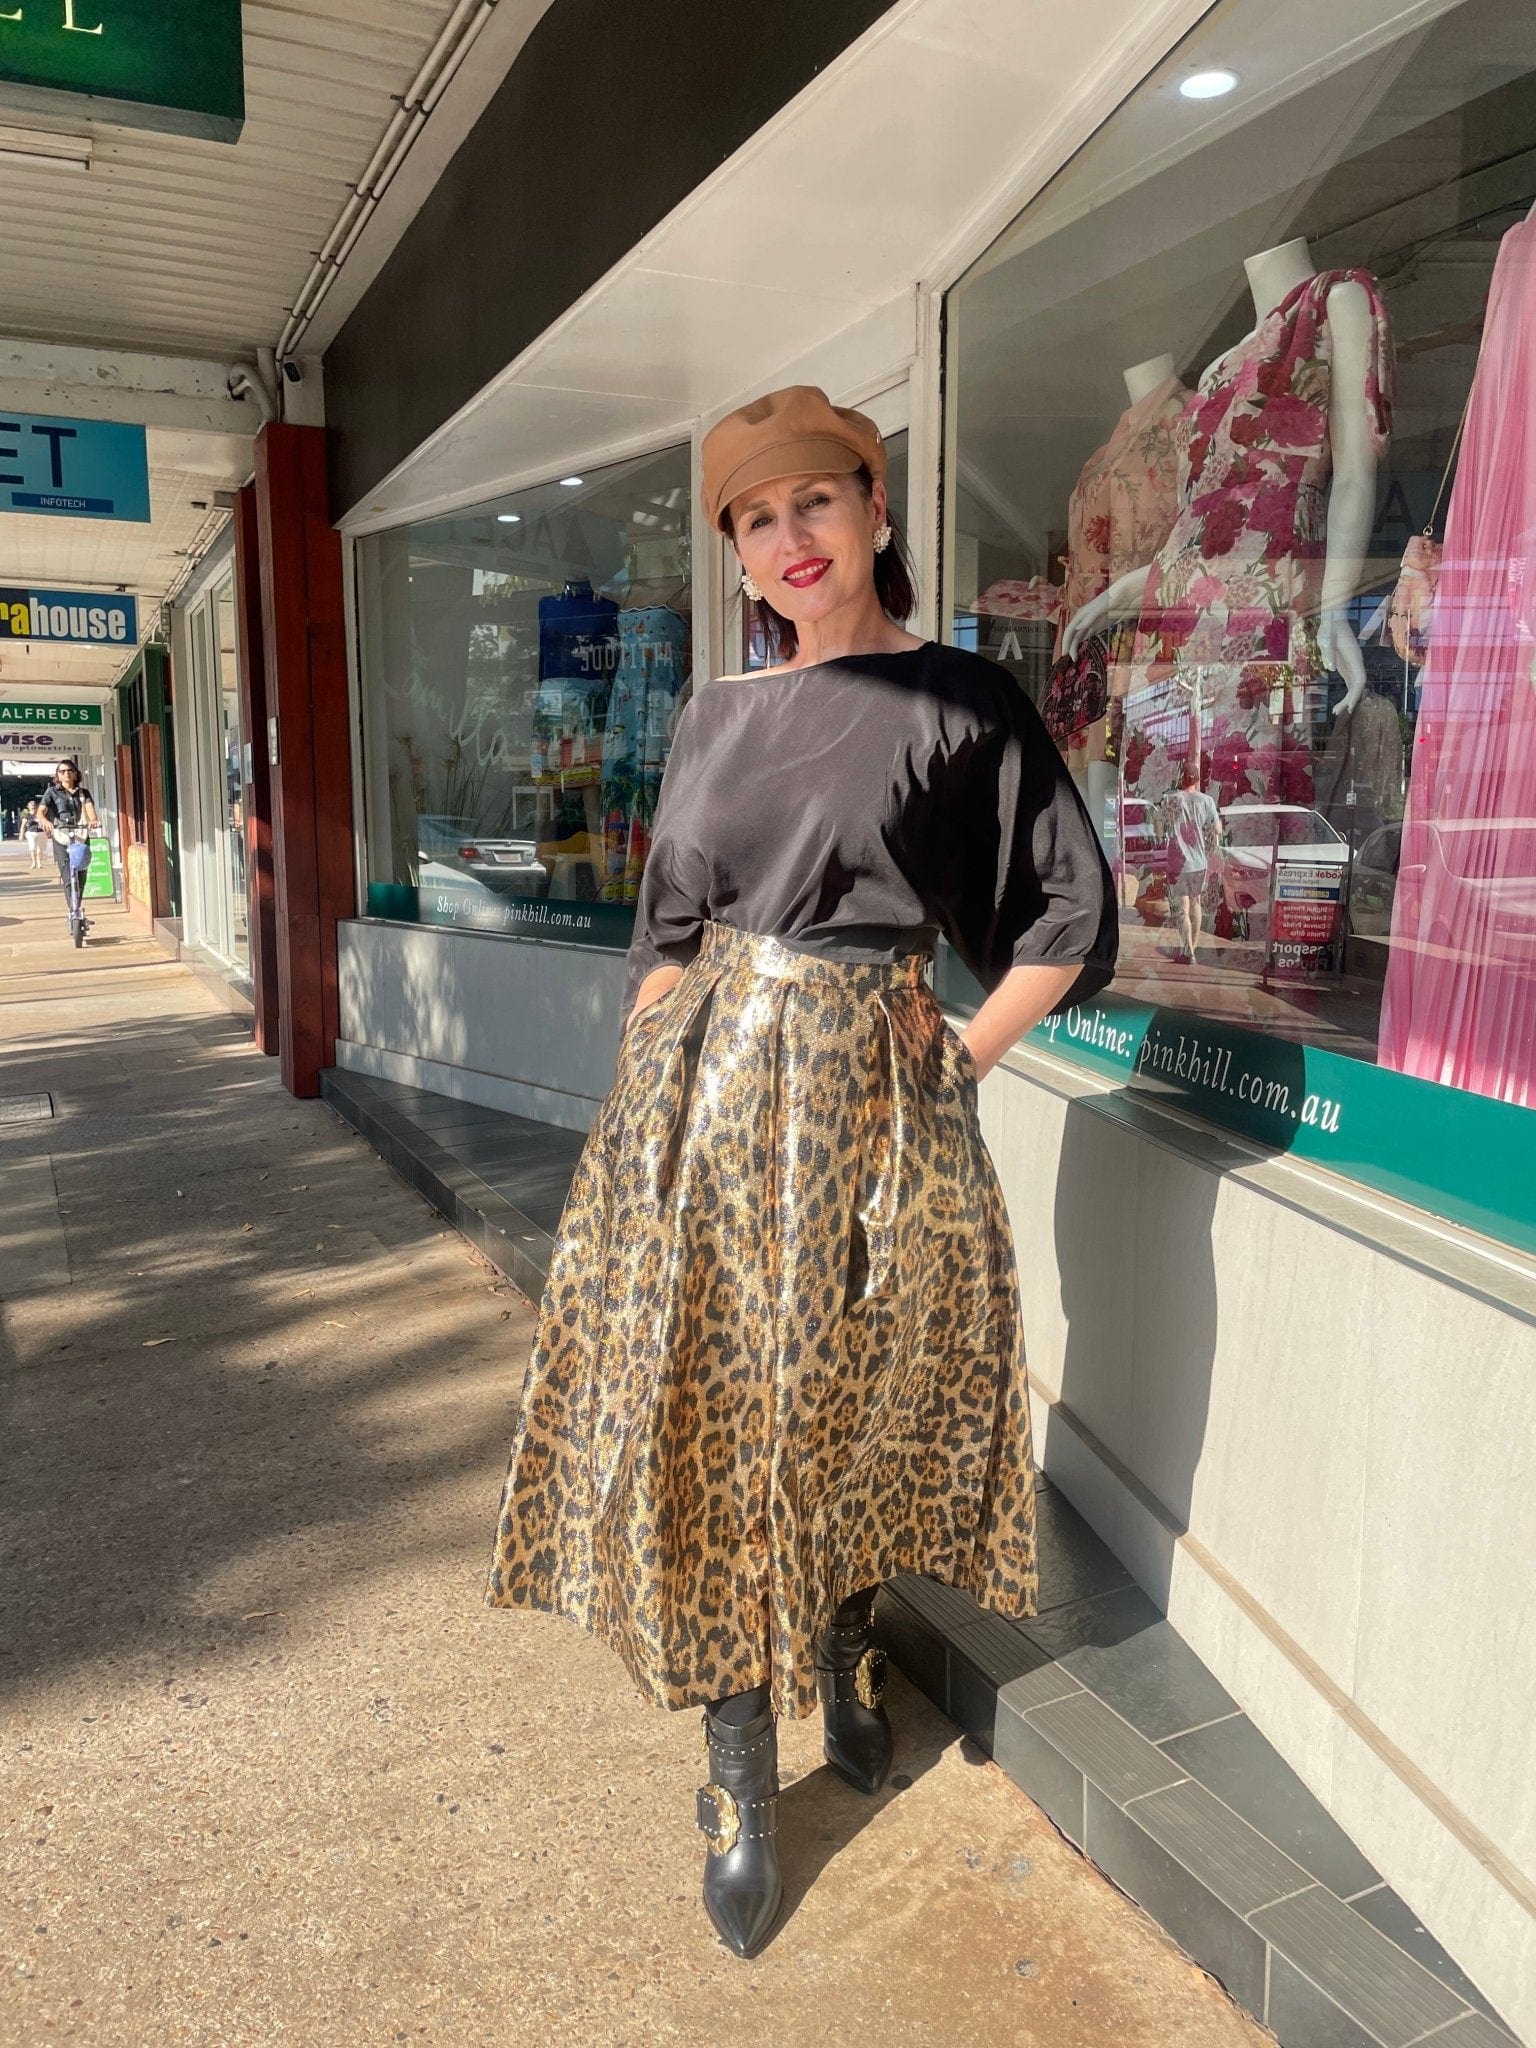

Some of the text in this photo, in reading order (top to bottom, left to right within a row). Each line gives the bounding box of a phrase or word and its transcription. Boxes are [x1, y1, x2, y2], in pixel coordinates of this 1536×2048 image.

[40, 496, 86, 509] INFOTECH
[1, 707, 89, 721] ALFRED'S
[437, 895, 460, 920] Shop
[502, 903, 592, 929] pinkhill.com.au
[1067, 1004, 1133, 1058] Online:
[1136, 1031, 1341, 1133] pinkhill.com.au
